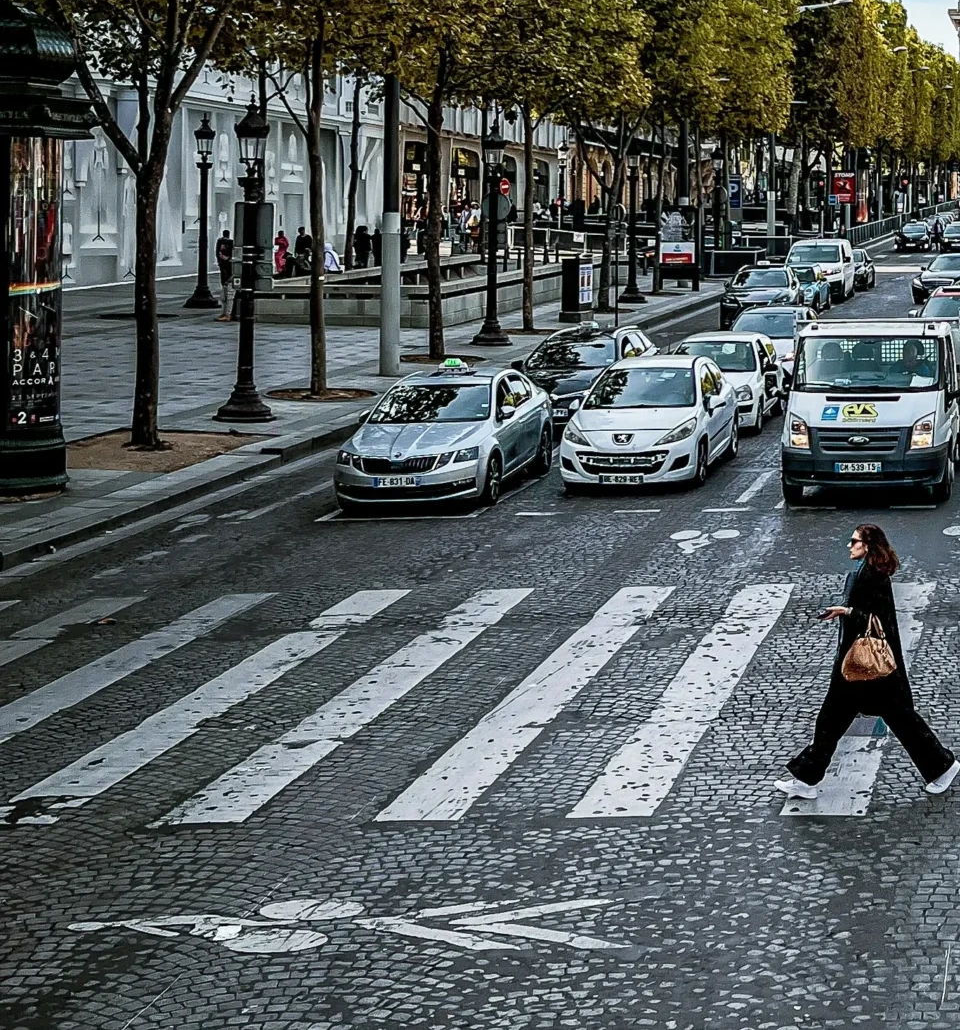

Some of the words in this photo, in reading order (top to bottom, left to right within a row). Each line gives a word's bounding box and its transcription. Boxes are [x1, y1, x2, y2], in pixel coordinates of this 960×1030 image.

[12, 349, 23, 362] 3
[41, 347, 50, 360] 4
[17, 411, 27, 425] 2
